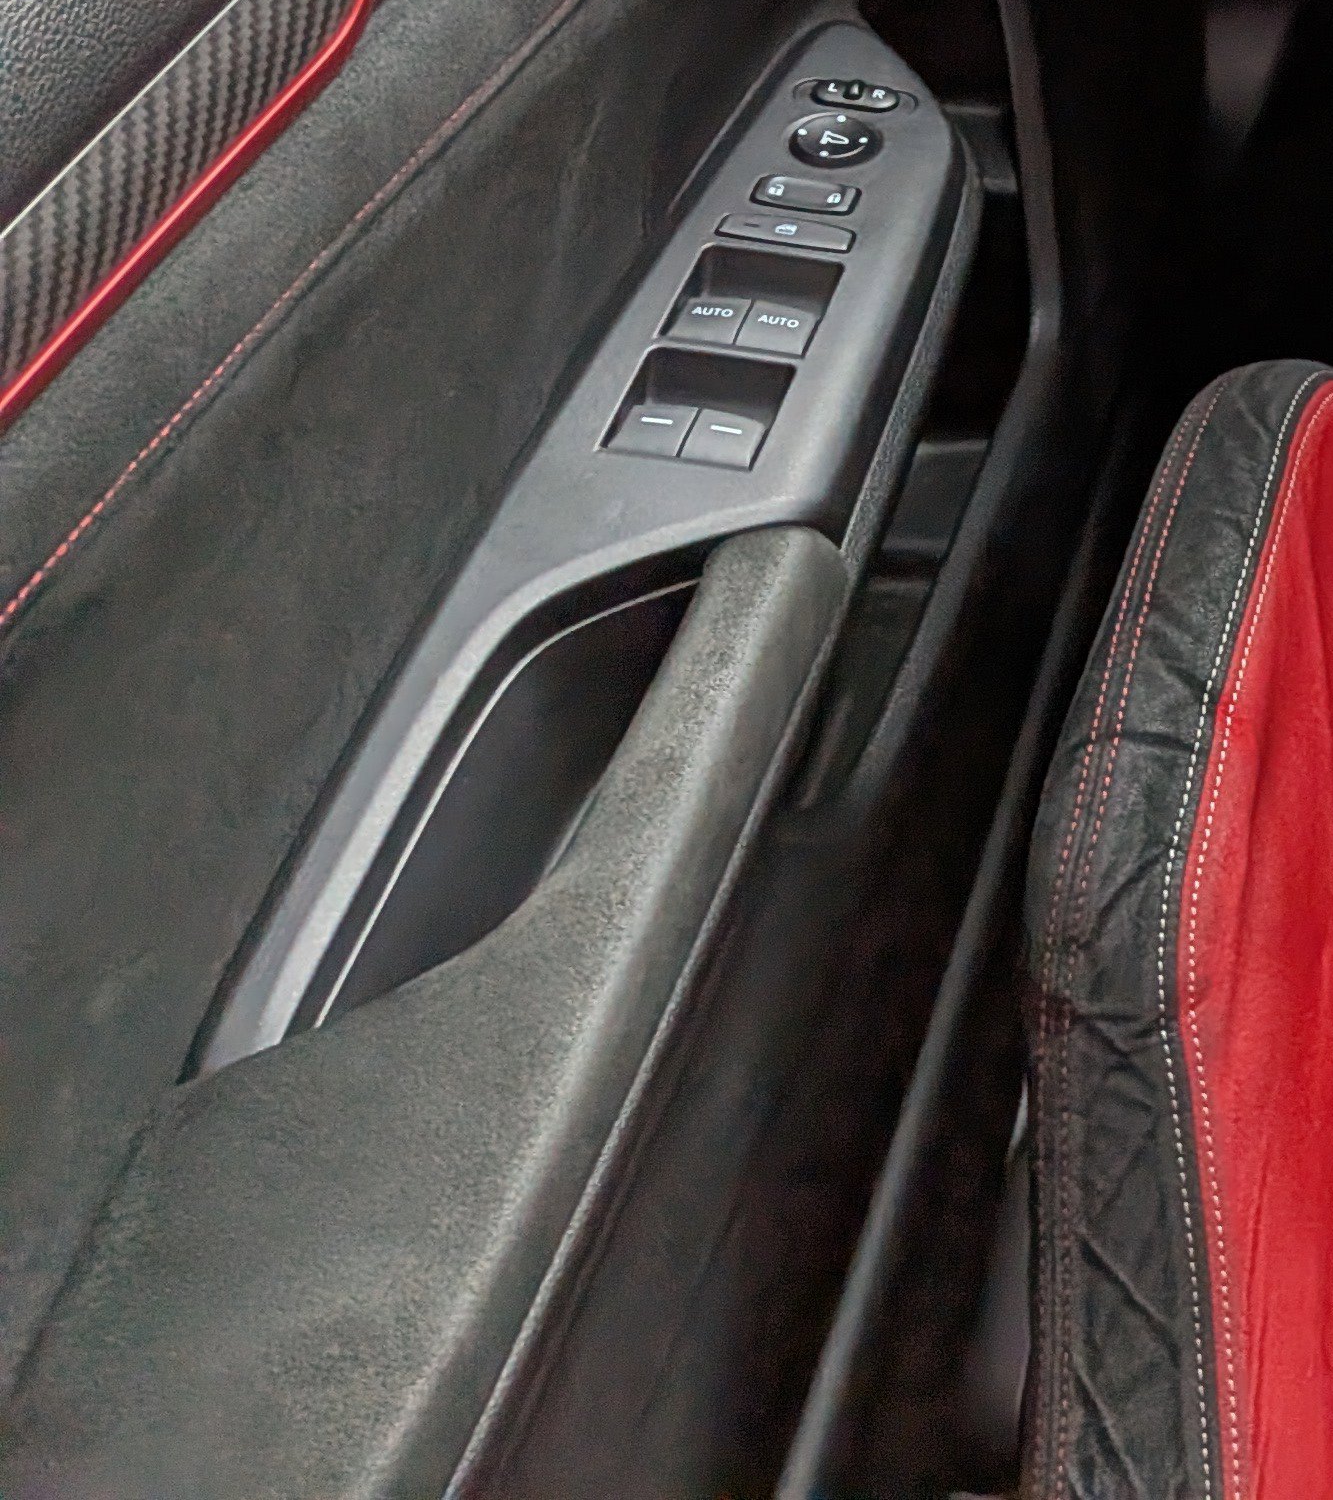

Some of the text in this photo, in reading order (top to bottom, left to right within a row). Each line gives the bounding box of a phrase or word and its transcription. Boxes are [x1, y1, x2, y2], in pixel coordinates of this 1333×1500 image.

[827, 82, 838, 93] L
[872, 88, 886, 100] R
[691, 305, 734, 318] AUTO
[757, 314, 799, 329] AUTO
